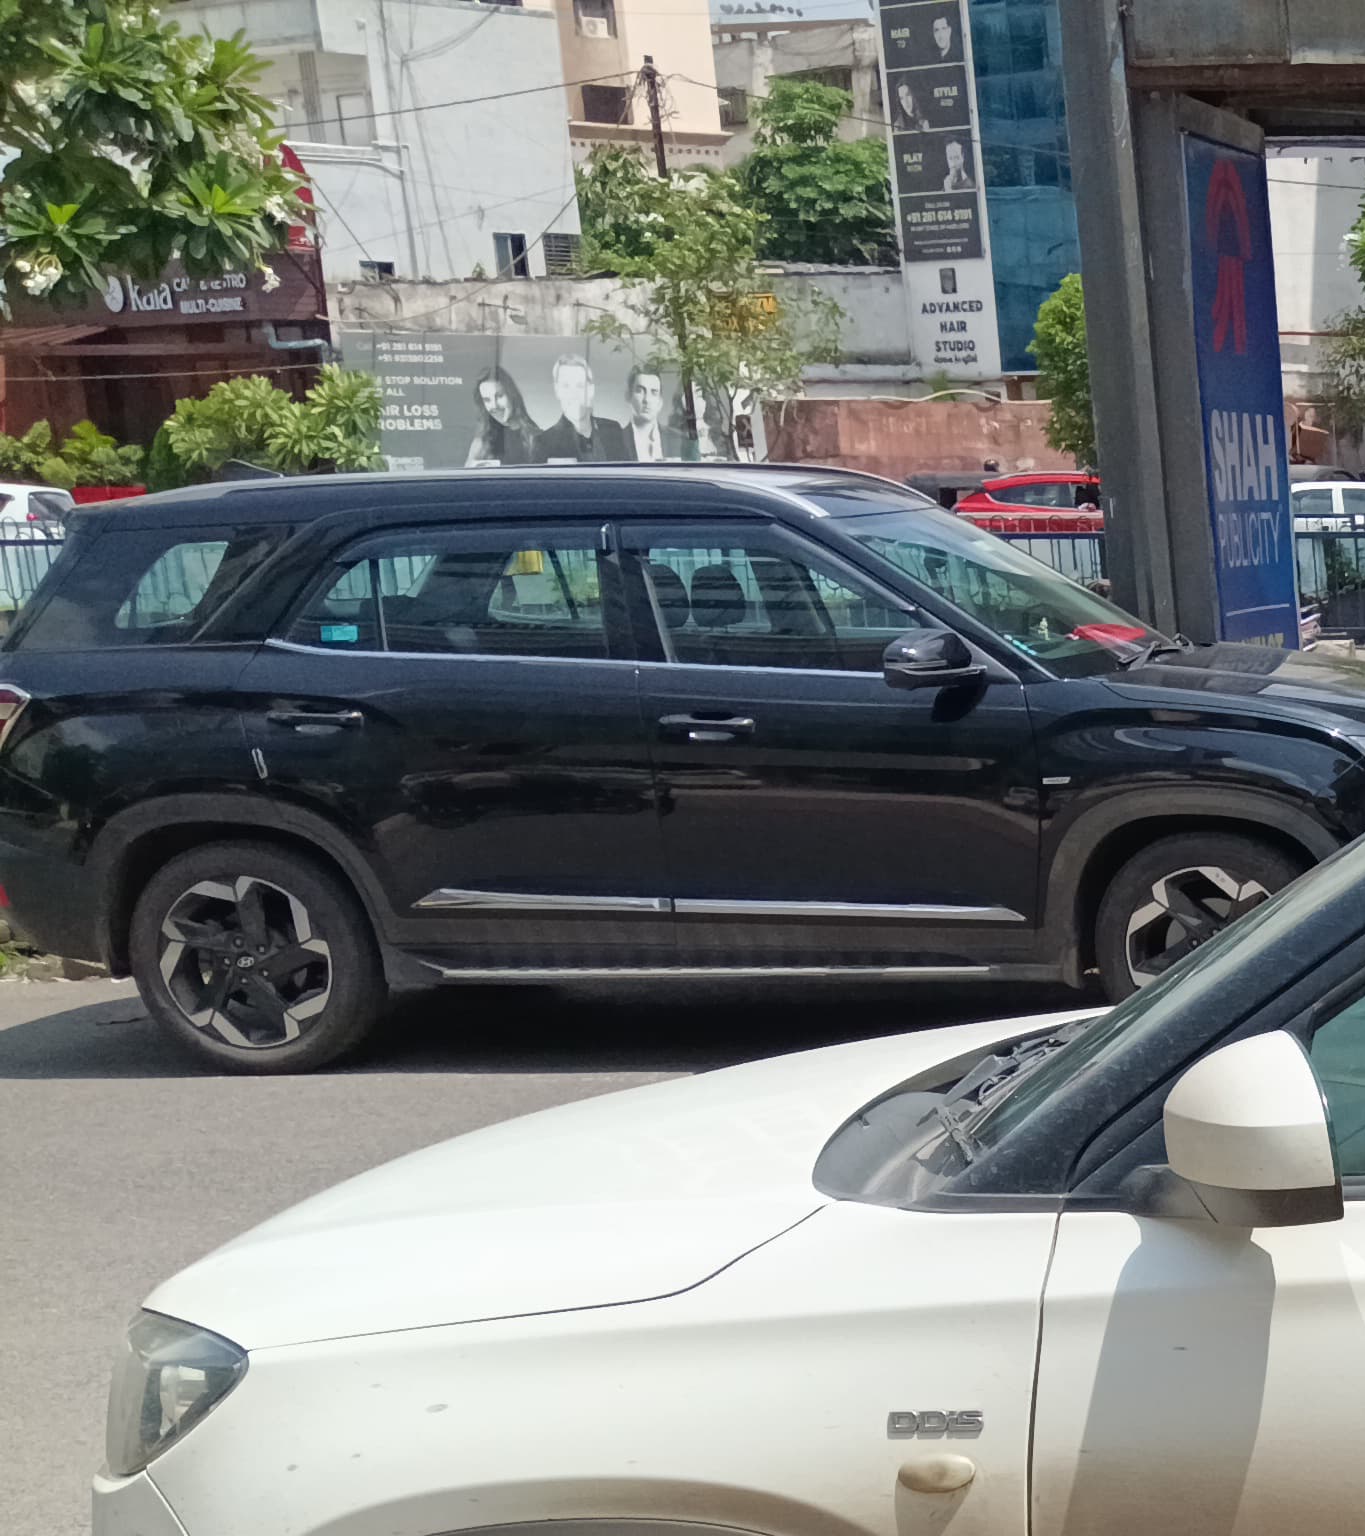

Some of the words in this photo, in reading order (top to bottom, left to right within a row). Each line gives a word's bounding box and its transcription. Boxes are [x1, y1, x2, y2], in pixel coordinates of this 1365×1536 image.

[921, 300, 983, 314] ADVANCED
[939, 320, 967, 333] HAIR
[935, 340, 975, 352] STUDIO
[385, 376, 411, 385] STOP
[413, 376, 463, 385] SOLUTION
[386, 388, 407, 397] ALL
[404, 405, 439, 416] LOSS
[377, 419, 443, 431] ROBLEMS
[1211, 408, 1279, 501] SHAH
[1218, 511, 1281, 568] PUBLICITY
